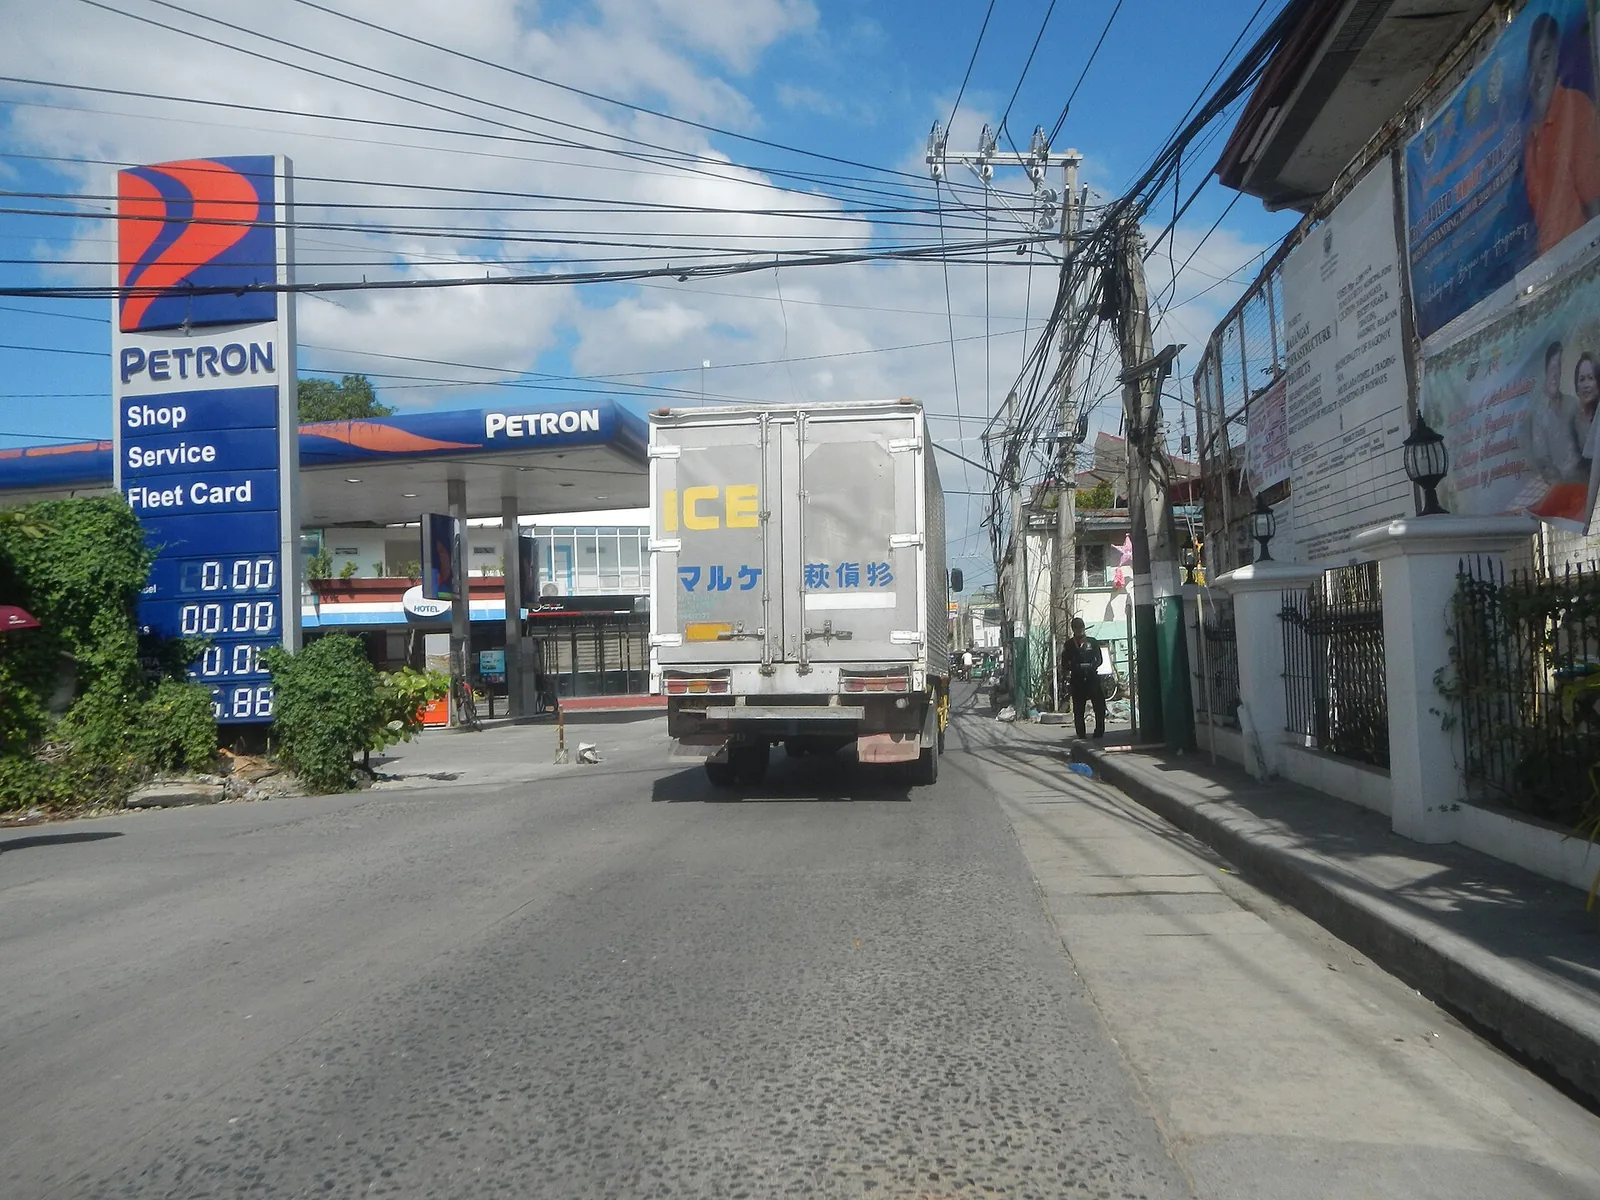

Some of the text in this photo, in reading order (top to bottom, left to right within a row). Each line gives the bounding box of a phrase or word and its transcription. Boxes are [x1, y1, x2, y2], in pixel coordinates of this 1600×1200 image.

[120, 342, 275, 383] PETRON
[127, 405, 187, 428] Shop
[486, 409, 600, 438] PETRON
[128, 443, 216, 468] Service
[128, 480, 252, 509] Fleet Card
[664, 484, 759, 532] ICE
[677, 565, 763, 592] マルケ
[181, 602, 274, 634] 00.00
[414, 605, 440, 613] HOTEL
